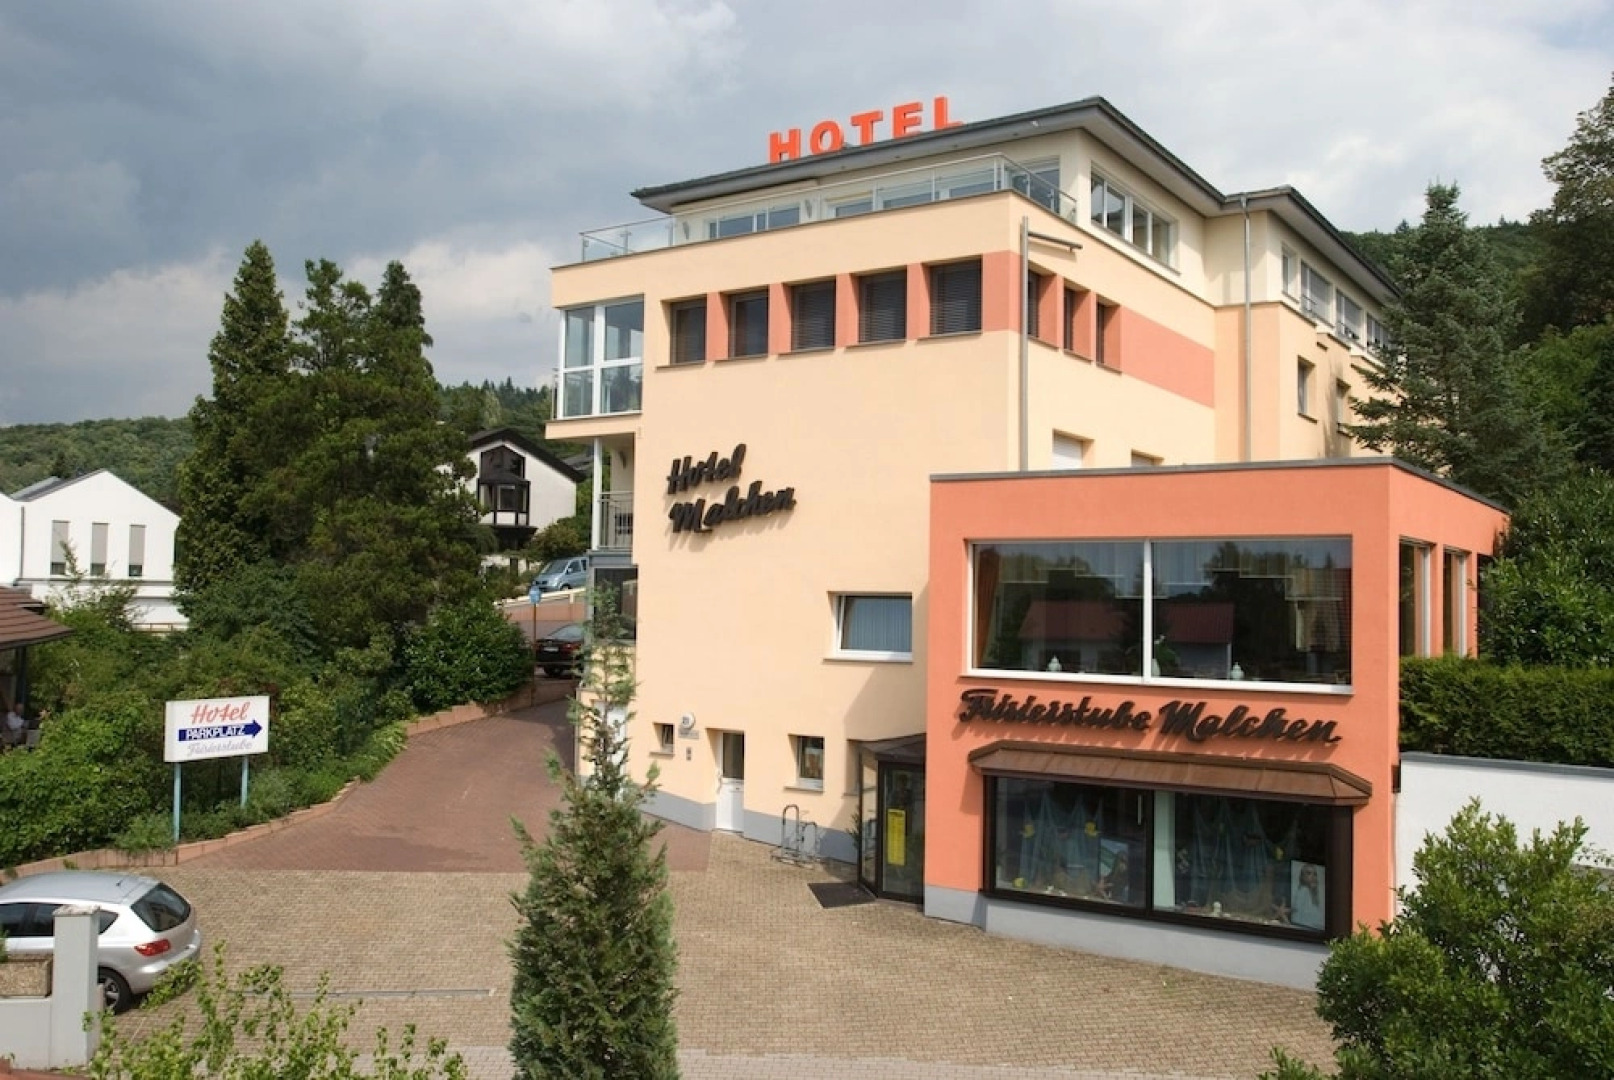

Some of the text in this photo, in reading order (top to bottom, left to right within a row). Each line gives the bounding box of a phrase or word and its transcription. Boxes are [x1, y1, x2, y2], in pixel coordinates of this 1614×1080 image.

[769, 96, 963, 165] HOTEL
[667, 443, 746, 494] Hotel
[668, 480, 797, 533] Malchen
[187, 725, 245, 740] PARKPLATZ
[190, 701, 251, 724] Hotel
[959, 688, 1342, 742] Frisierstube Malchen
